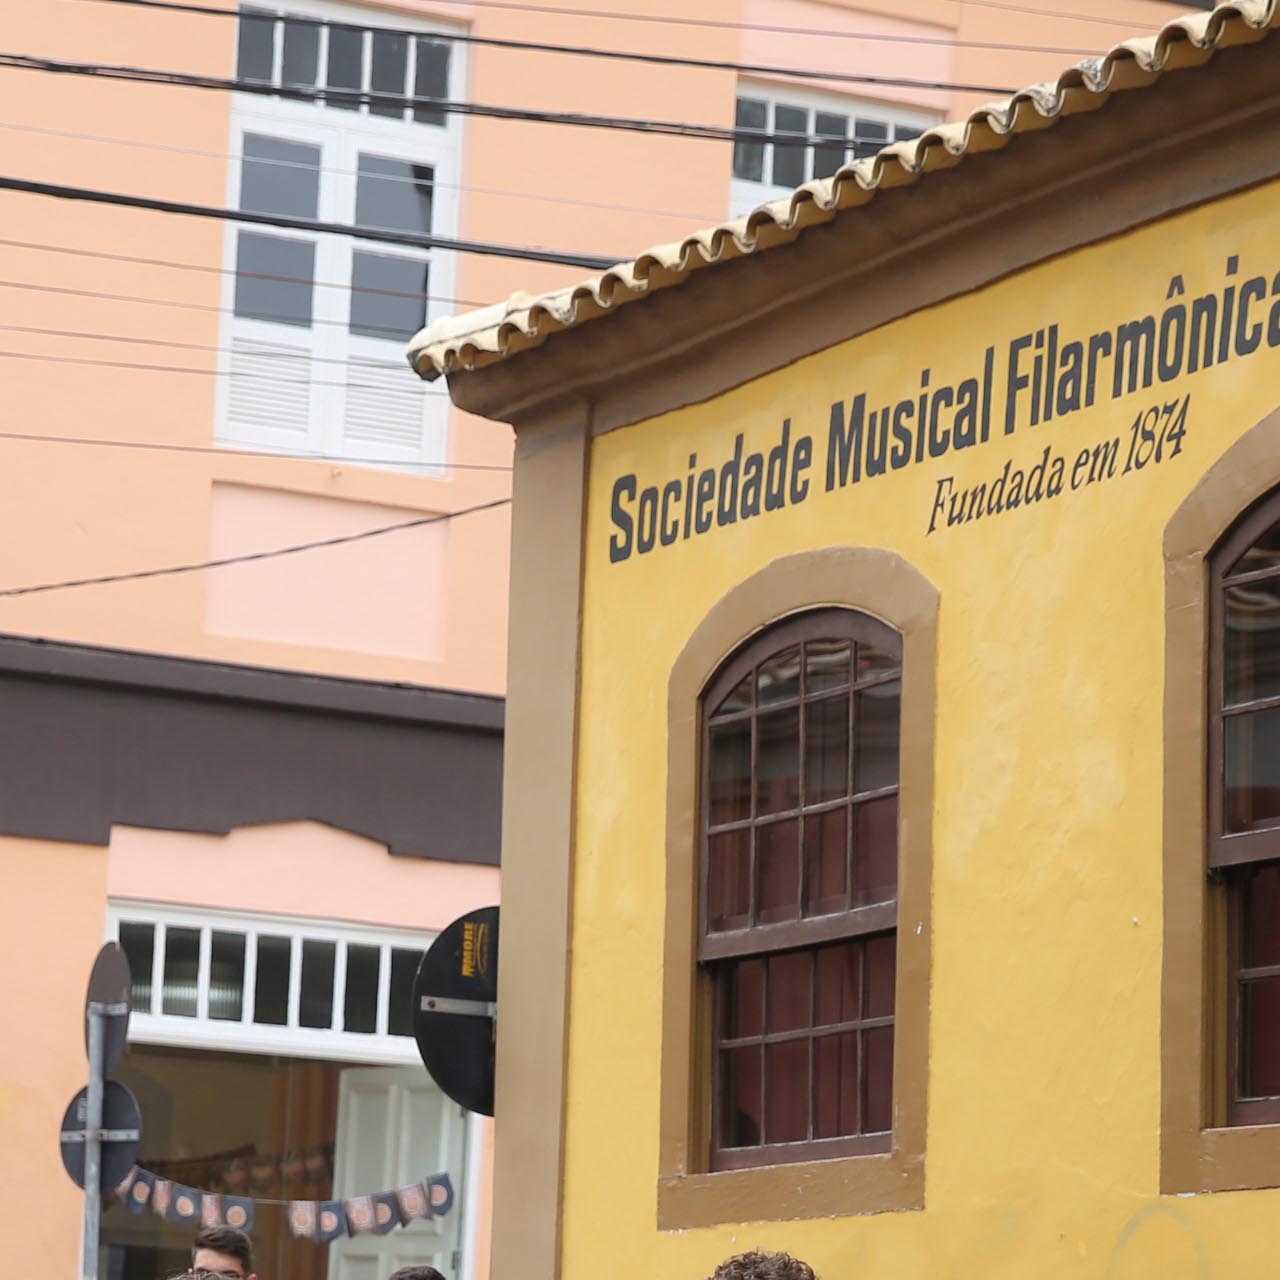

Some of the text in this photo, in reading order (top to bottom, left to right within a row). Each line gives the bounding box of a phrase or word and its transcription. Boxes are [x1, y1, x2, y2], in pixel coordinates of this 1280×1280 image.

[608, 417, 813, 564] Sociedade
[825, 345, 994, 492] Musical
[926, 393, 1190, 535] Fundada em 1874
